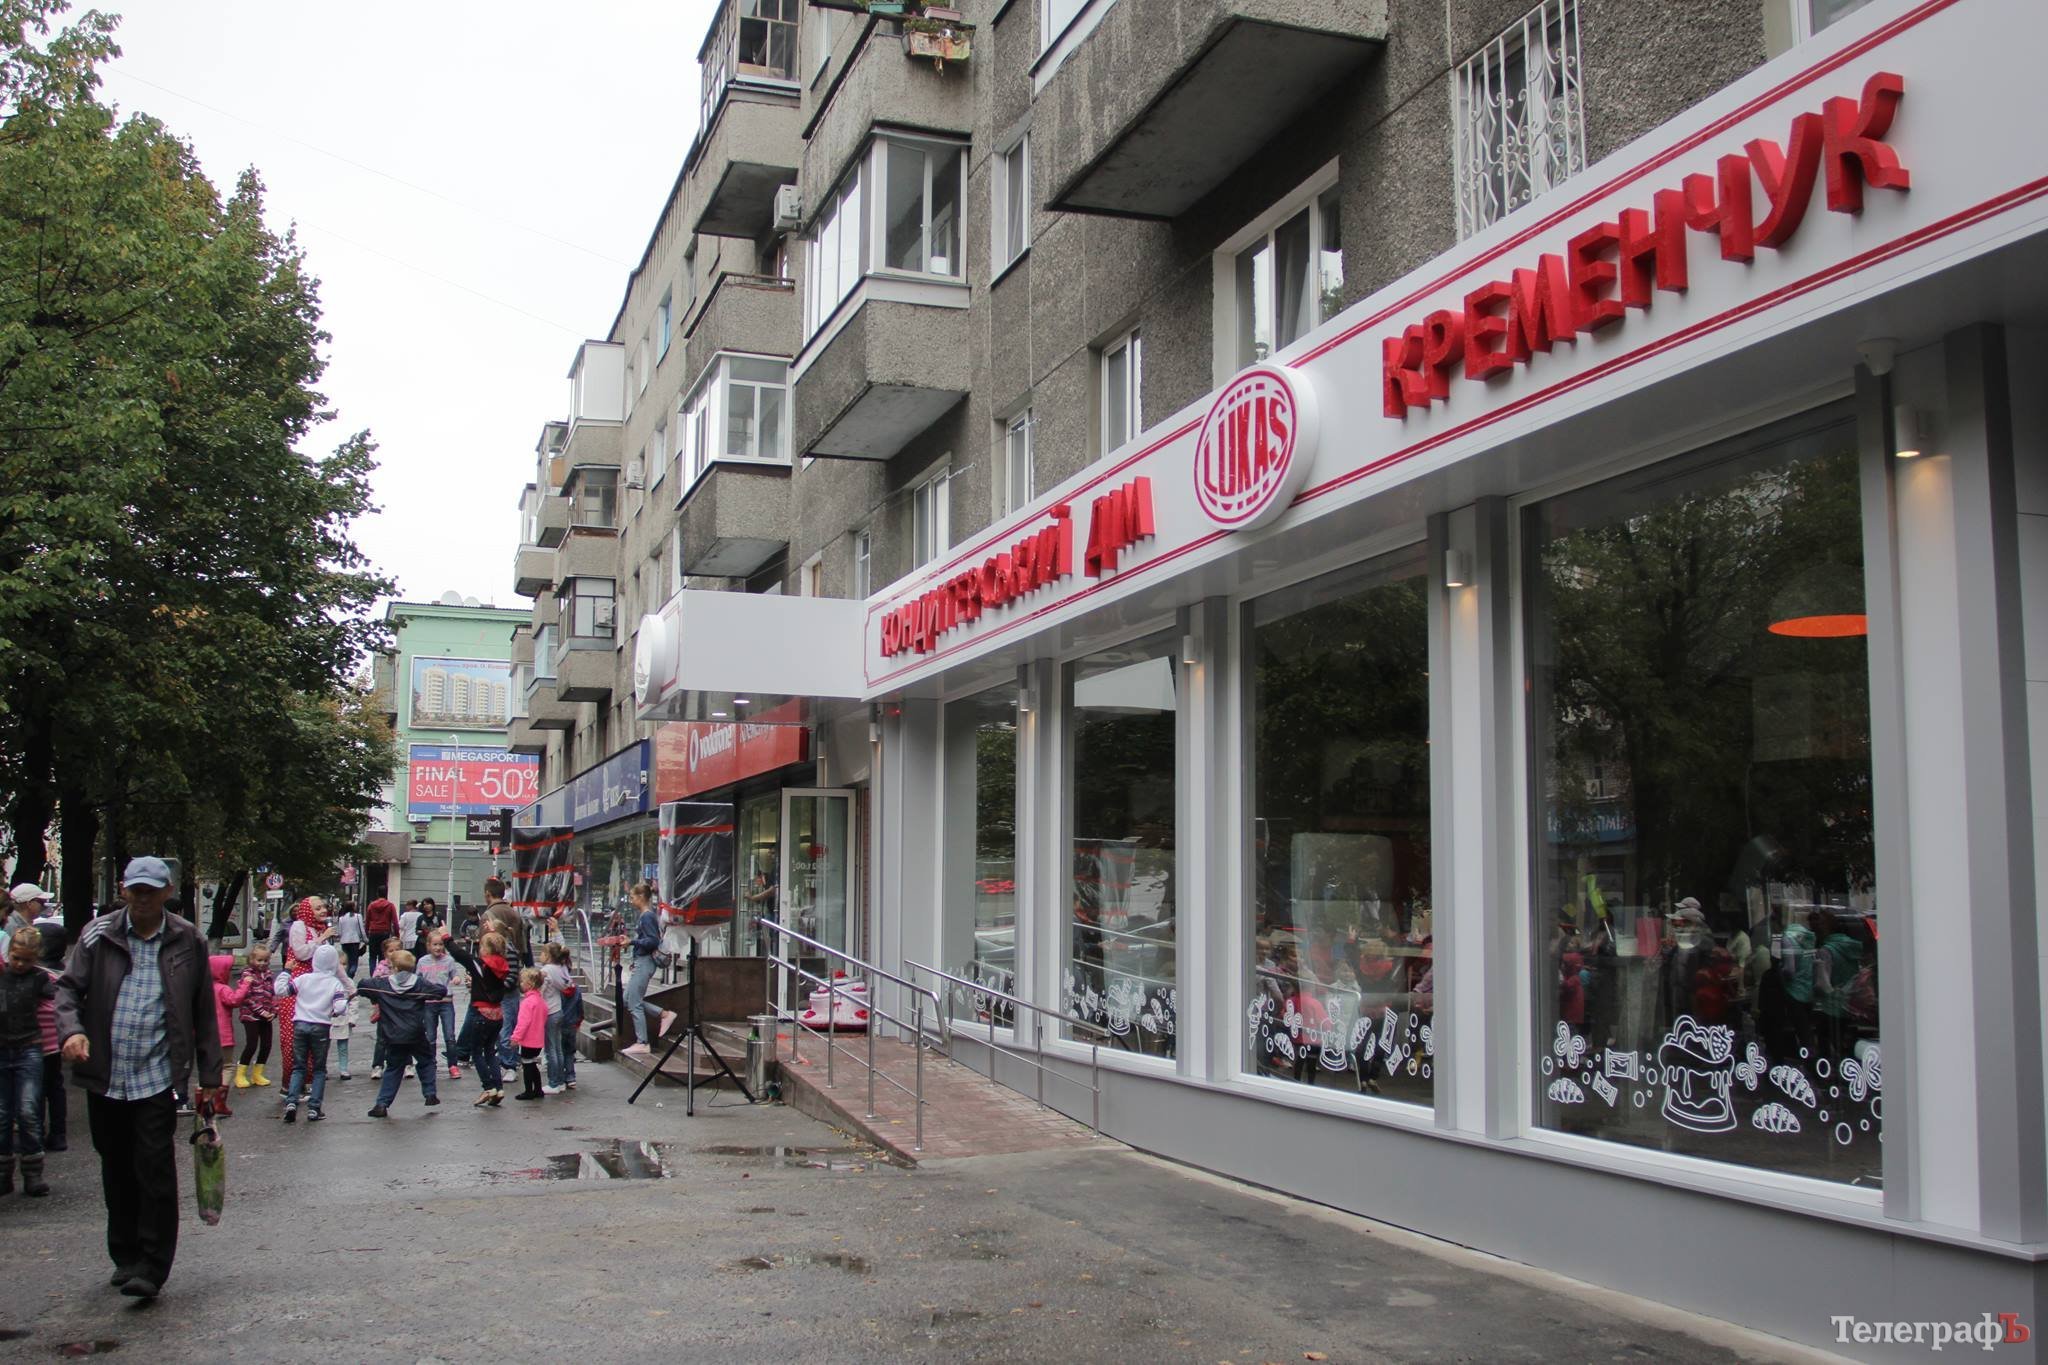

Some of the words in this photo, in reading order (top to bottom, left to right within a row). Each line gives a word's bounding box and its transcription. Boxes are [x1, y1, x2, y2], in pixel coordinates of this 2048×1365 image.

[1382, 71, 1911, 420] КРЕМЕНЧУК
[1203, 392, 1288, 500] LUKAS
[1084, 475, 1156, 578] ДІМ
[415, 766, 467, 782] FINAL
[451, 751, 521, 763] MEGASPORT
[415, 784, 449, 798] SALE
